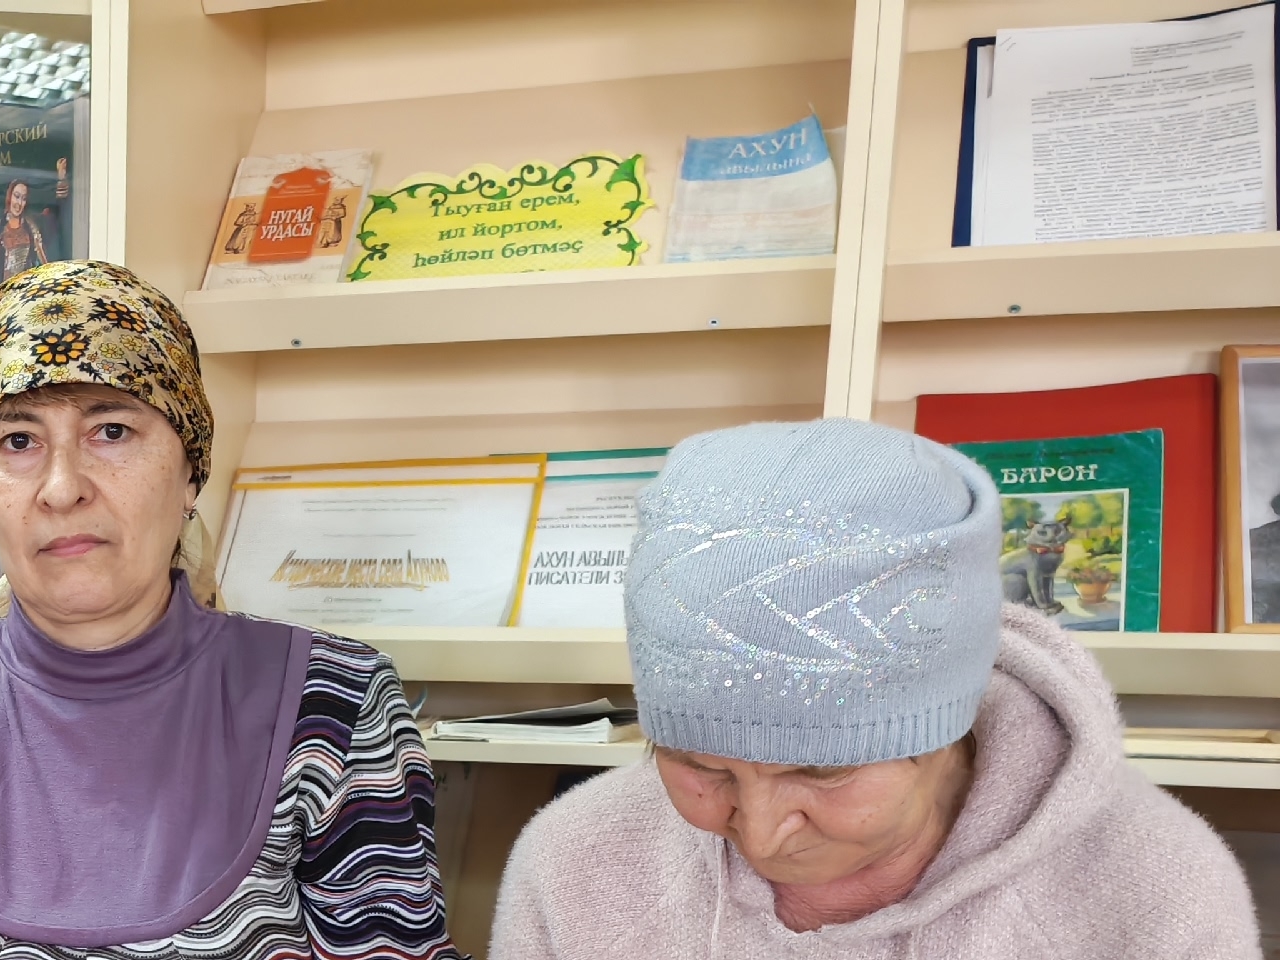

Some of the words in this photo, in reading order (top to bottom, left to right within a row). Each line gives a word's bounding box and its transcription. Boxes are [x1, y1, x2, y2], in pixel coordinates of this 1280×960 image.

[727, 127, 808, 159] АХУН
[269, 206, 315, 225] НУГАЙ
[431, 199, 512, 218] Тыуған
[520, 193, 581, 212] ерем,
[260, 222, 316, 241] УРДАСЫ
[437, 227, 466, 241] ил
[472, 218, 563, 239] йортом,
[1000, 463, 1099, 485] БАРОН
[533, 550, 575, 568] АХУН
[527, 571, 611, 586] ПИСАТЕЛИ
